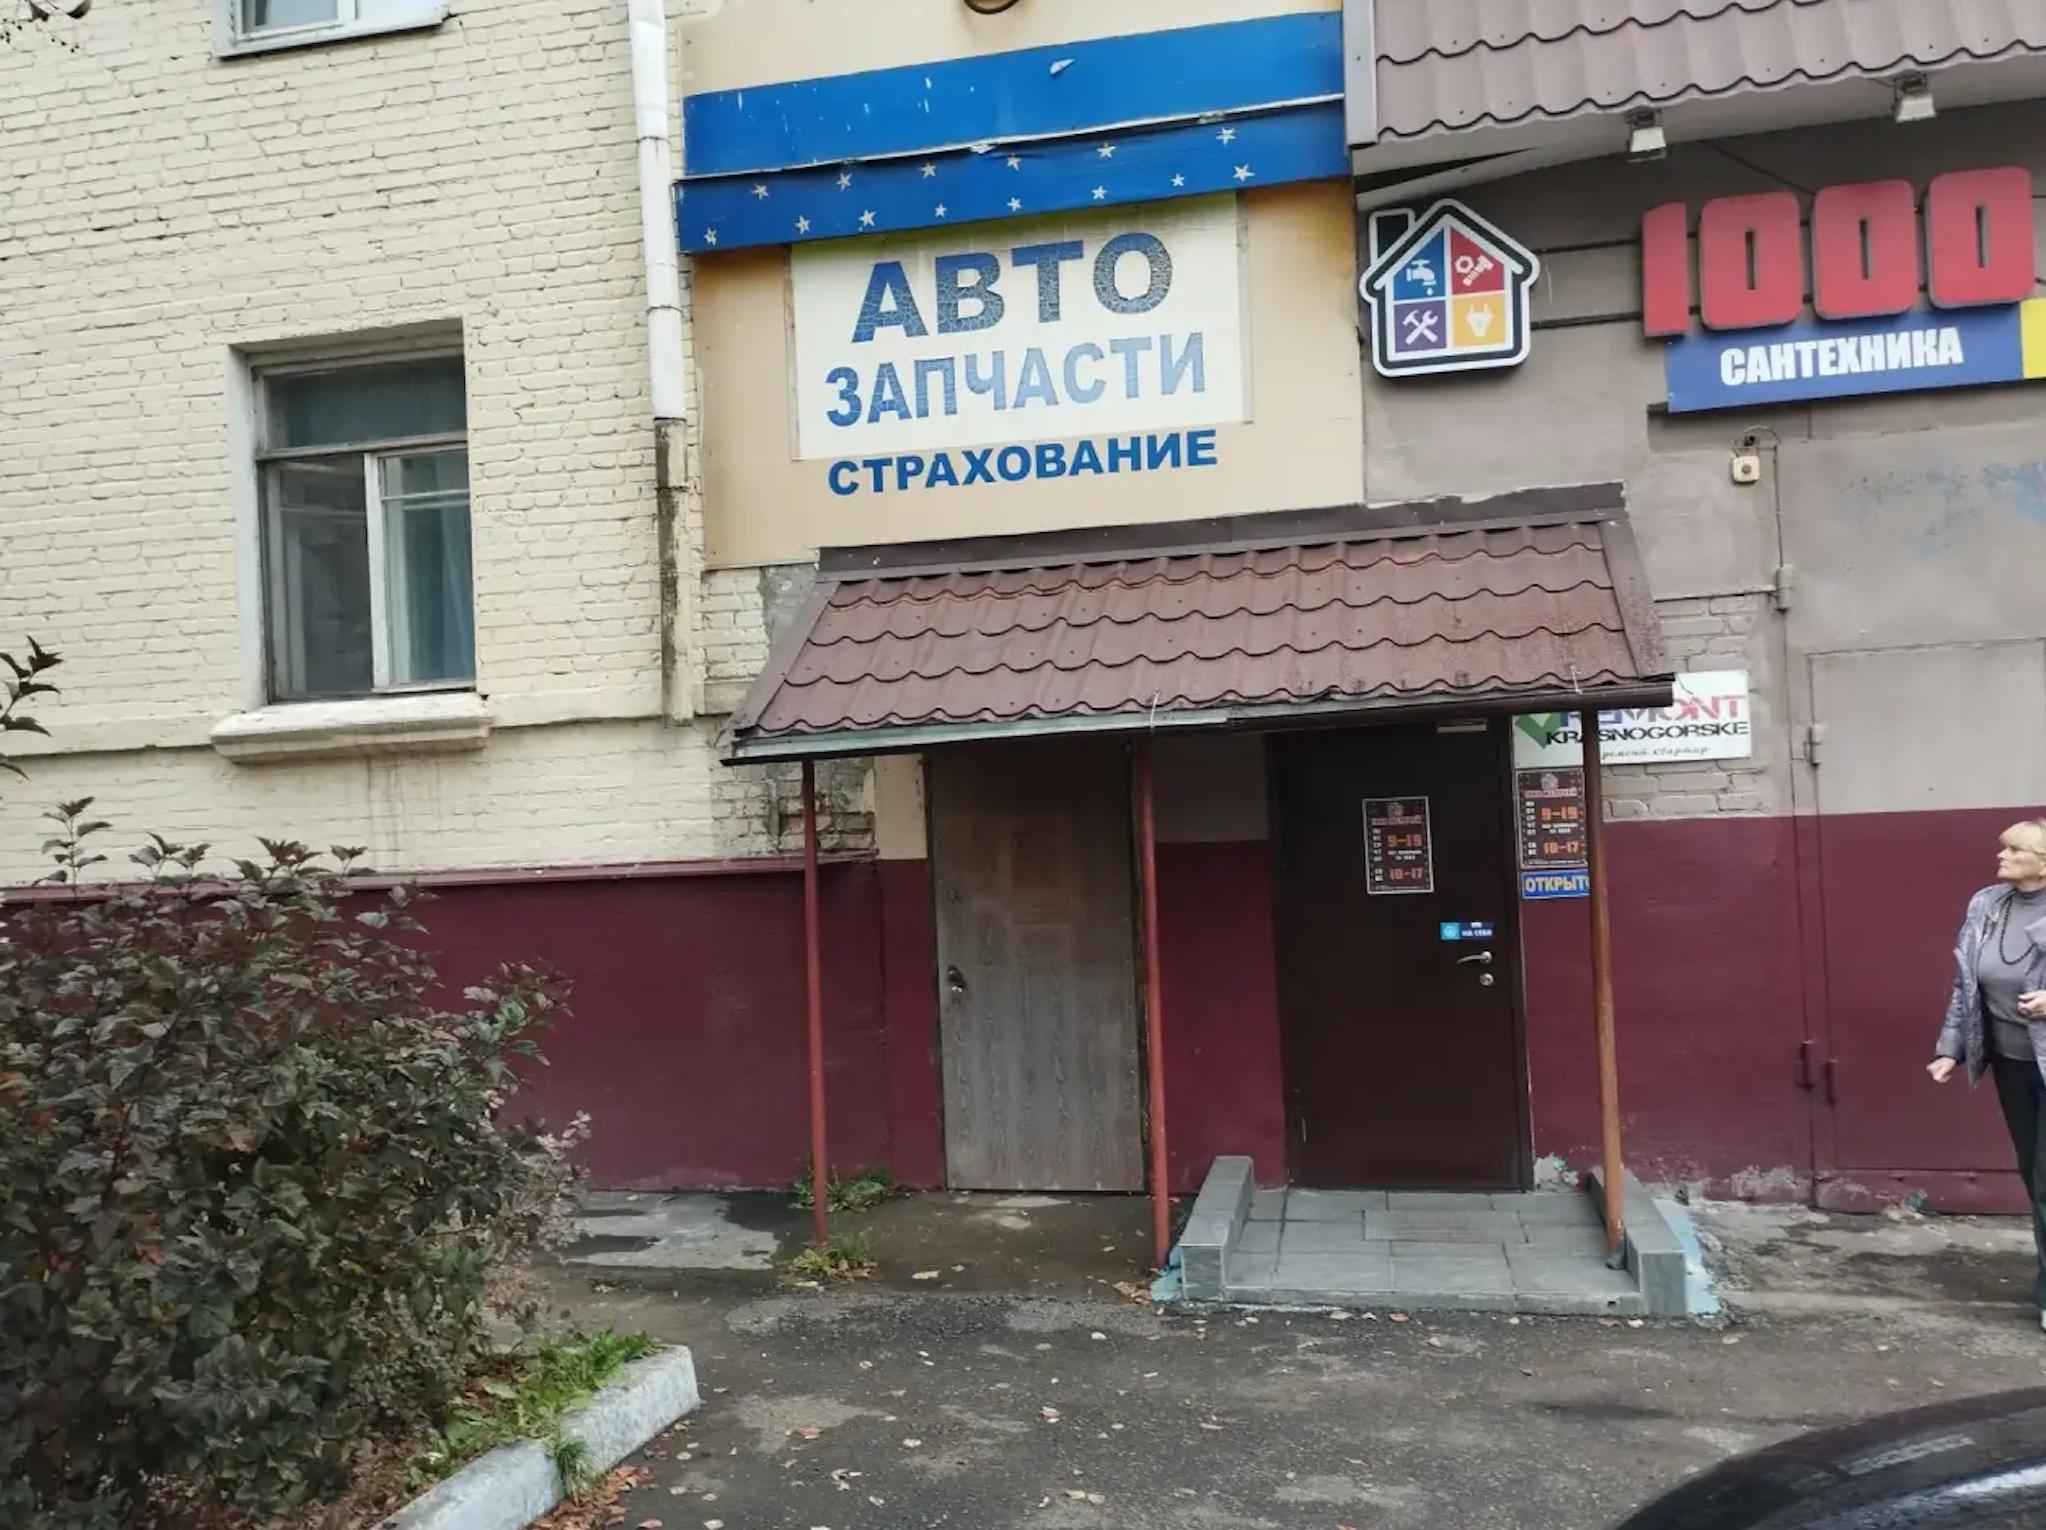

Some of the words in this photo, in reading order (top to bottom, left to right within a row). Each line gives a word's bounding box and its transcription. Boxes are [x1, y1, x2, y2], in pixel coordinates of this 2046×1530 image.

[1642, 166, 2035, 337] 1000
[852, 232, 1173, 343] АВТО
[825, 332, 1206, 427] ЗАПЧАСТИ
[1720, 327, 1963, 387] САНТЕХНИКА
[828, 429, 1218, 496] СТРАХОВАНИЕ
[1546, 721, 1749, 745] KRSNOGORSKE
[1524, 875, 1590, 893] ОТКРЫТ
